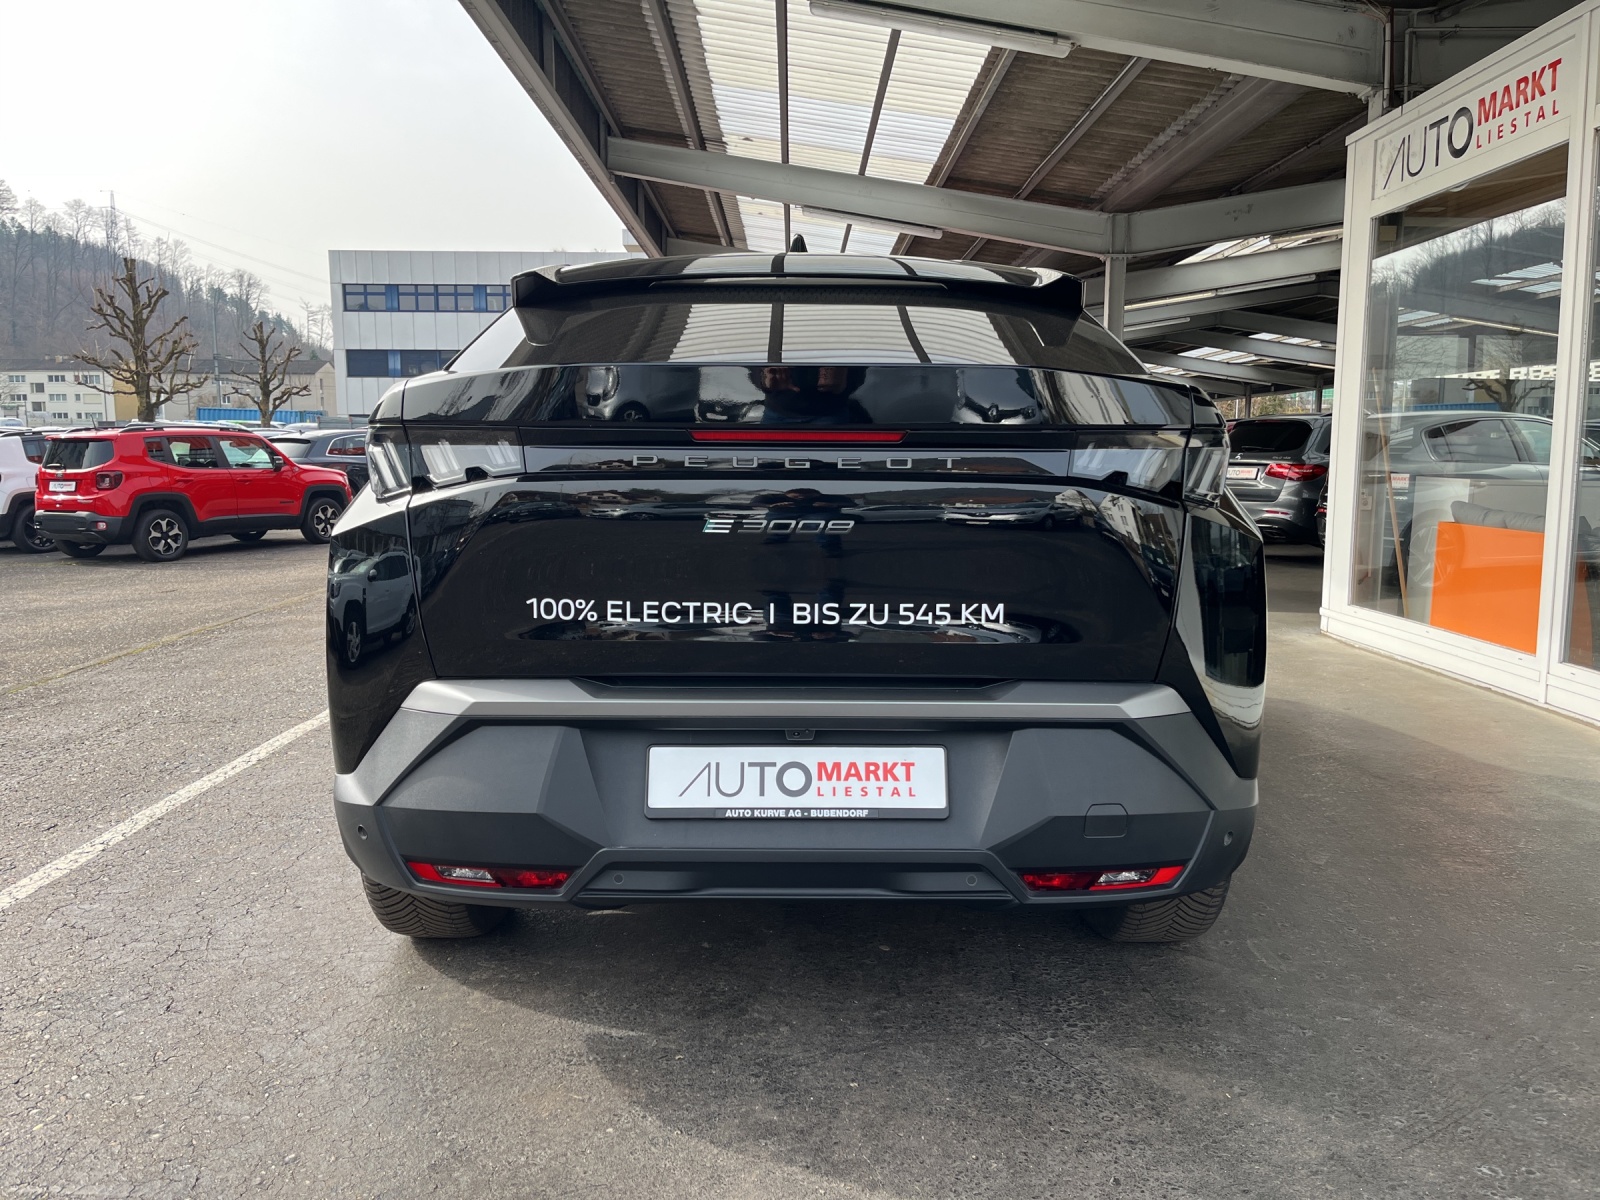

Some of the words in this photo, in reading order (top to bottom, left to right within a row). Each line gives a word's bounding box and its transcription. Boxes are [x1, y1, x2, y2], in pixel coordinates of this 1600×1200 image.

[1383, 106, 1474, 191] AUTO
[1477, 58, 1562, 127] MARKT
[1476, 99, 1559, 150] LIESTAL
[632, 454, 962, 470] PEUGEOT
[526, 597, 598, 622] 100%
[606, 600, 752, 624] ELECTRIC
[793, 602, 840, 625] BIS
[848, 603, 889, 625] ZU
[898, 603, 951, 625] 545
[961, 603, 1004, 624] KM
[678, 761, 813, 798] AUTO
[816, 761, 916, 782] MARKT
[816, 786, 916, 797] LIESTAL
[725, 809, 752, 818] AUTO
[754, 809, 786, 818] KURVE
[788, 809, 802, 818] AG
[810, 809, 869, 818] BUBENDORF
